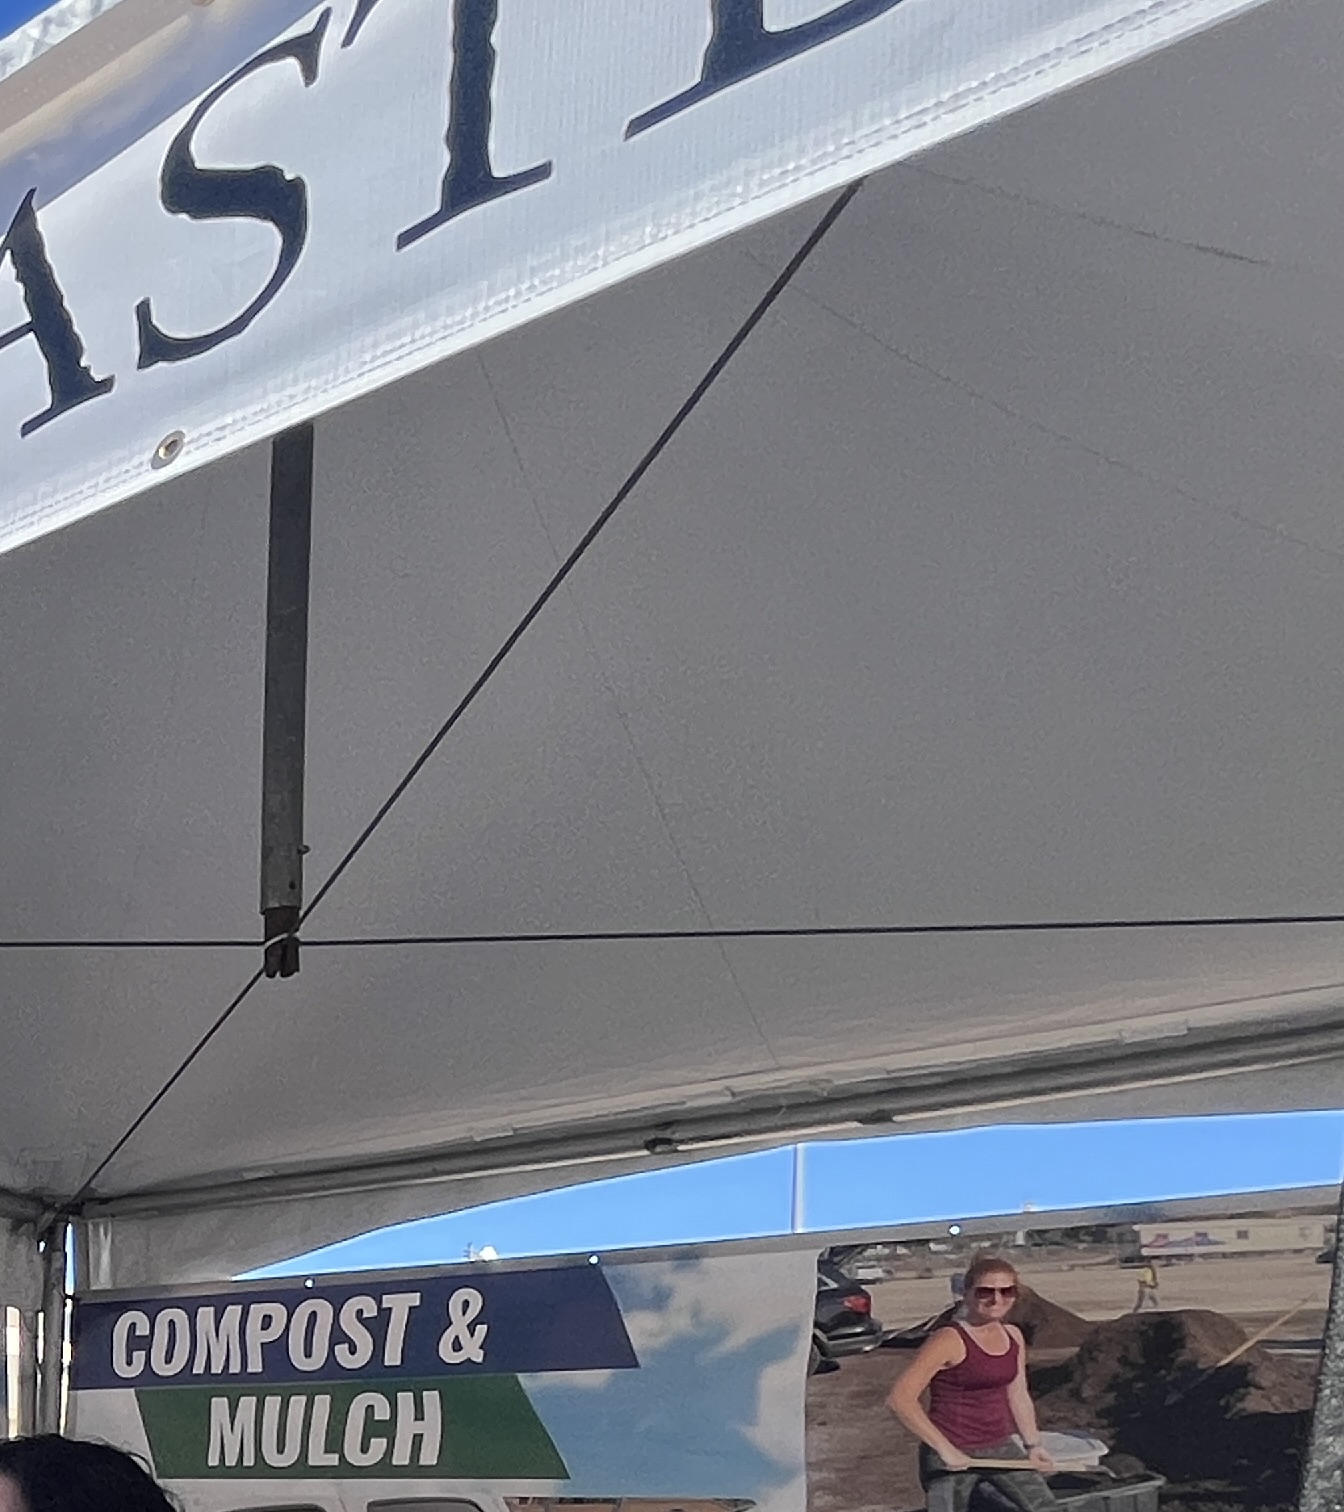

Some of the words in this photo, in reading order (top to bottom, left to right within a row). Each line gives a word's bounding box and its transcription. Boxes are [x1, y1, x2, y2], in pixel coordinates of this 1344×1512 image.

[112, 1291, 421, 1379] COMPOST
[437, 1287, 489, 1364] &
[206, 1390, 443, 1468] MULCH
